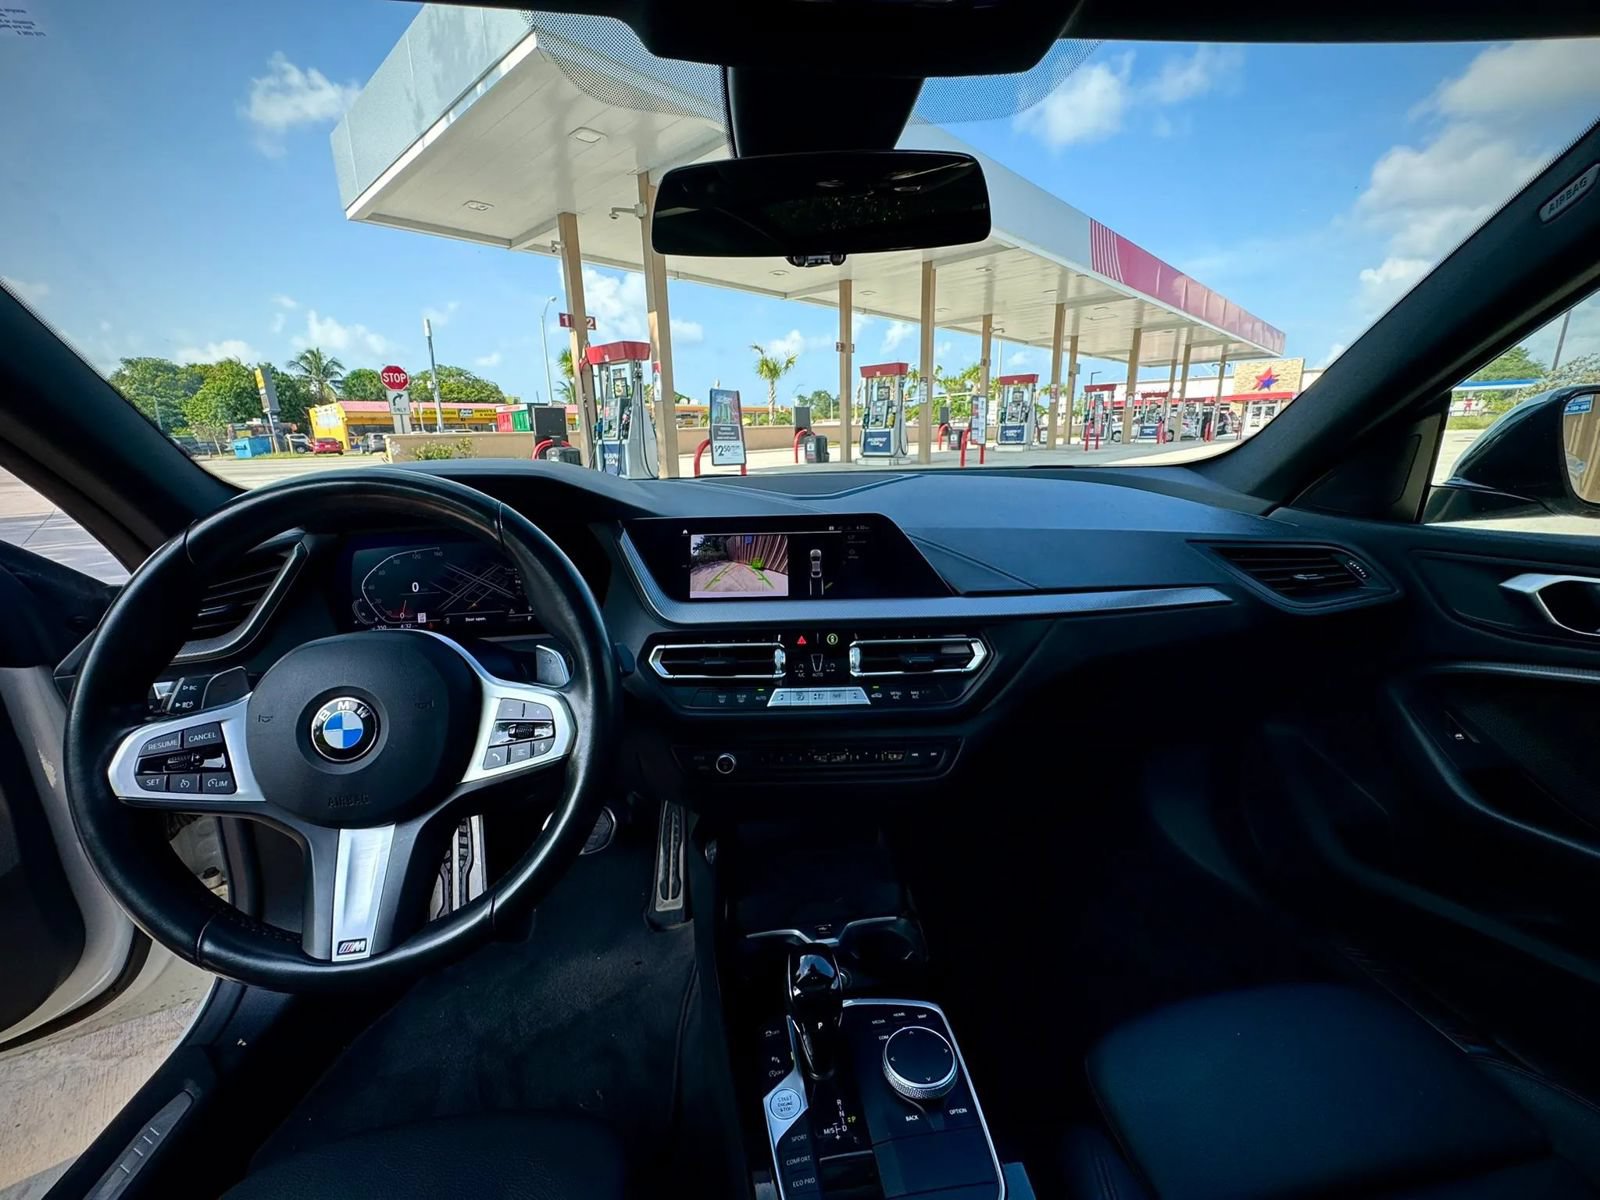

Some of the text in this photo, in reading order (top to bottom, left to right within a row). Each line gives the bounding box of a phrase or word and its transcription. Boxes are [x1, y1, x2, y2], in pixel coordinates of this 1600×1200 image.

[1548, 176, 1588, 214] AIRBAG
[562, 315, 569, 326] 1
[586, 317, 594, 328] 2
[383, 373, 406, 383] STOP
[411, 582, 419, 592] 0
[319, 701, 371, 722] BMW
[188, 732, 217, 742] CANCEL
[148, 740, 178, 751] RESUME
[146, 778, 160, 787] SET
[328, 794, 369, 808] AIRBAG
[817, 1021, 824, 1030] P
[842, 1124, 848, 1132] D
[791, 1134, 807, 1142] SPORT
[786, 1155, 810, 1166] COMFORT
[792, 1177, 816, 1188] ECO PRO
